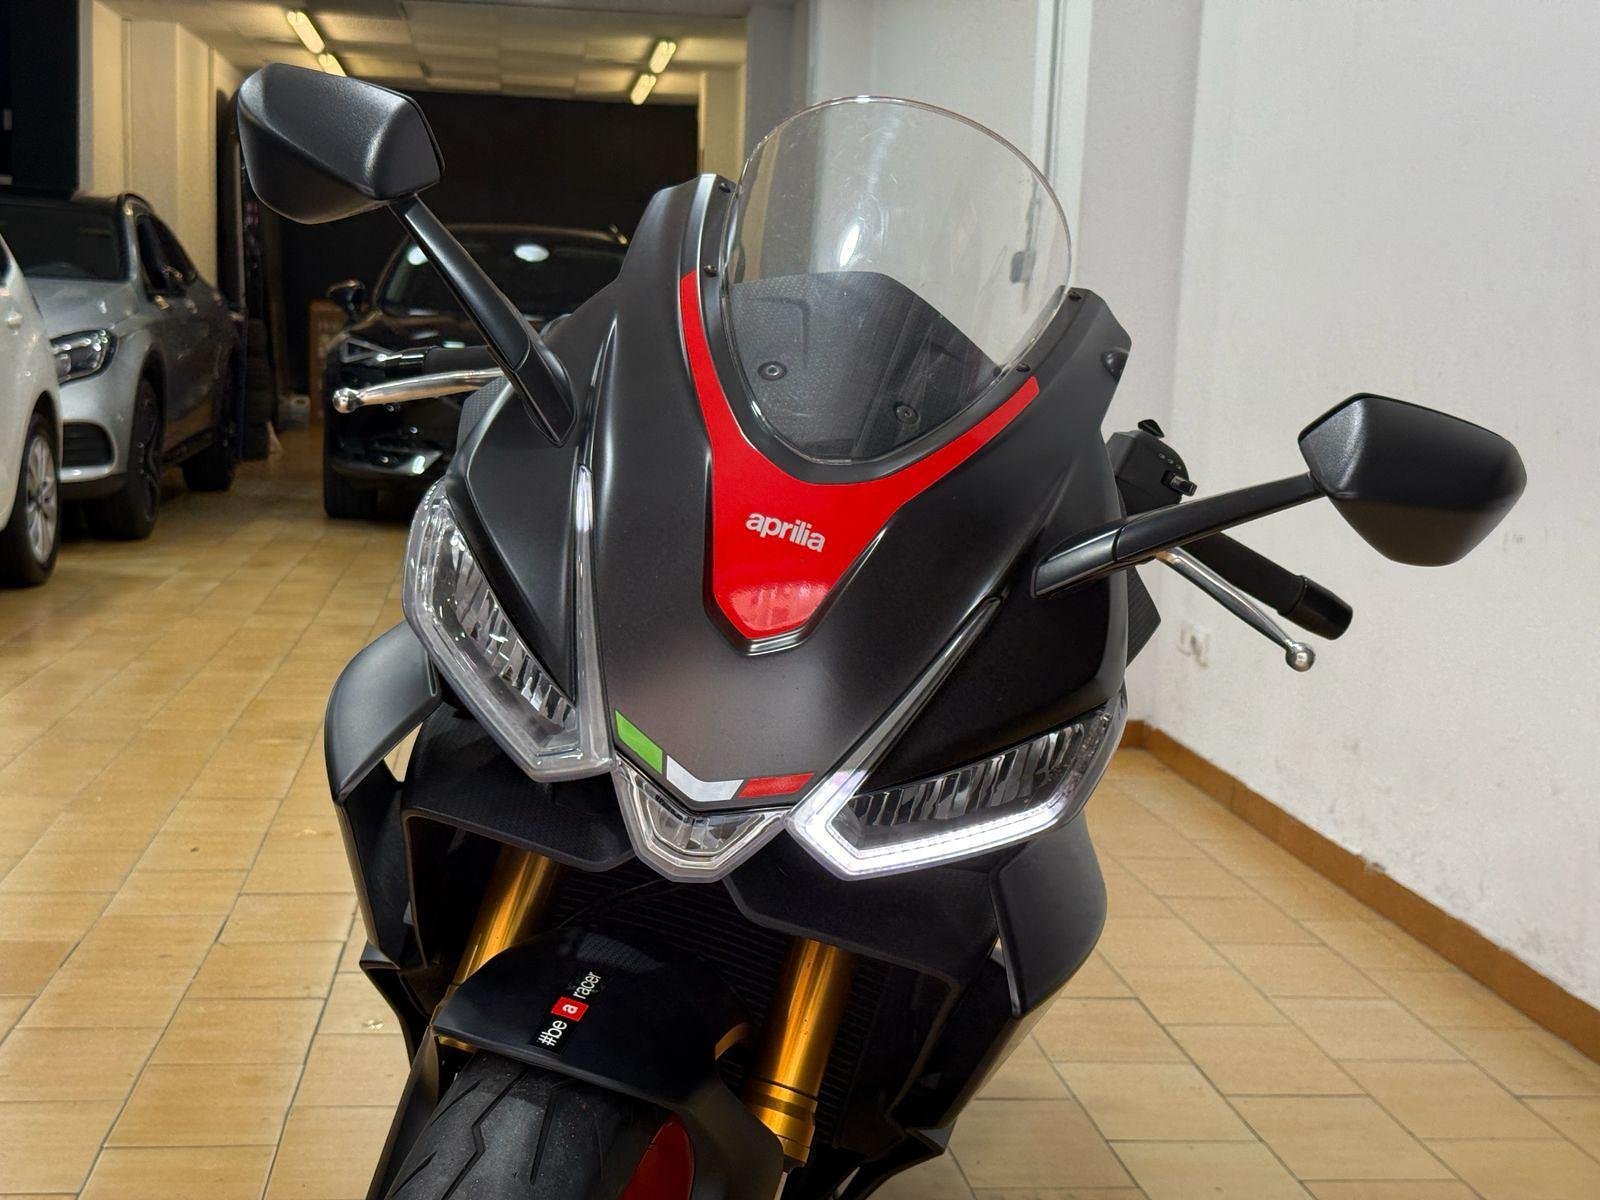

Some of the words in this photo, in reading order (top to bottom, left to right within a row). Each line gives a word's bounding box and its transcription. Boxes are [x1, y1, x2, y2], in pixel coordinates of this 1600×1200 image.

[745, 512, 826, 552] aprilia
[538, 1020, 567, 1046] #be
[562, 1004, 579, 1014] a
[573, 971, 601, 999] racer
